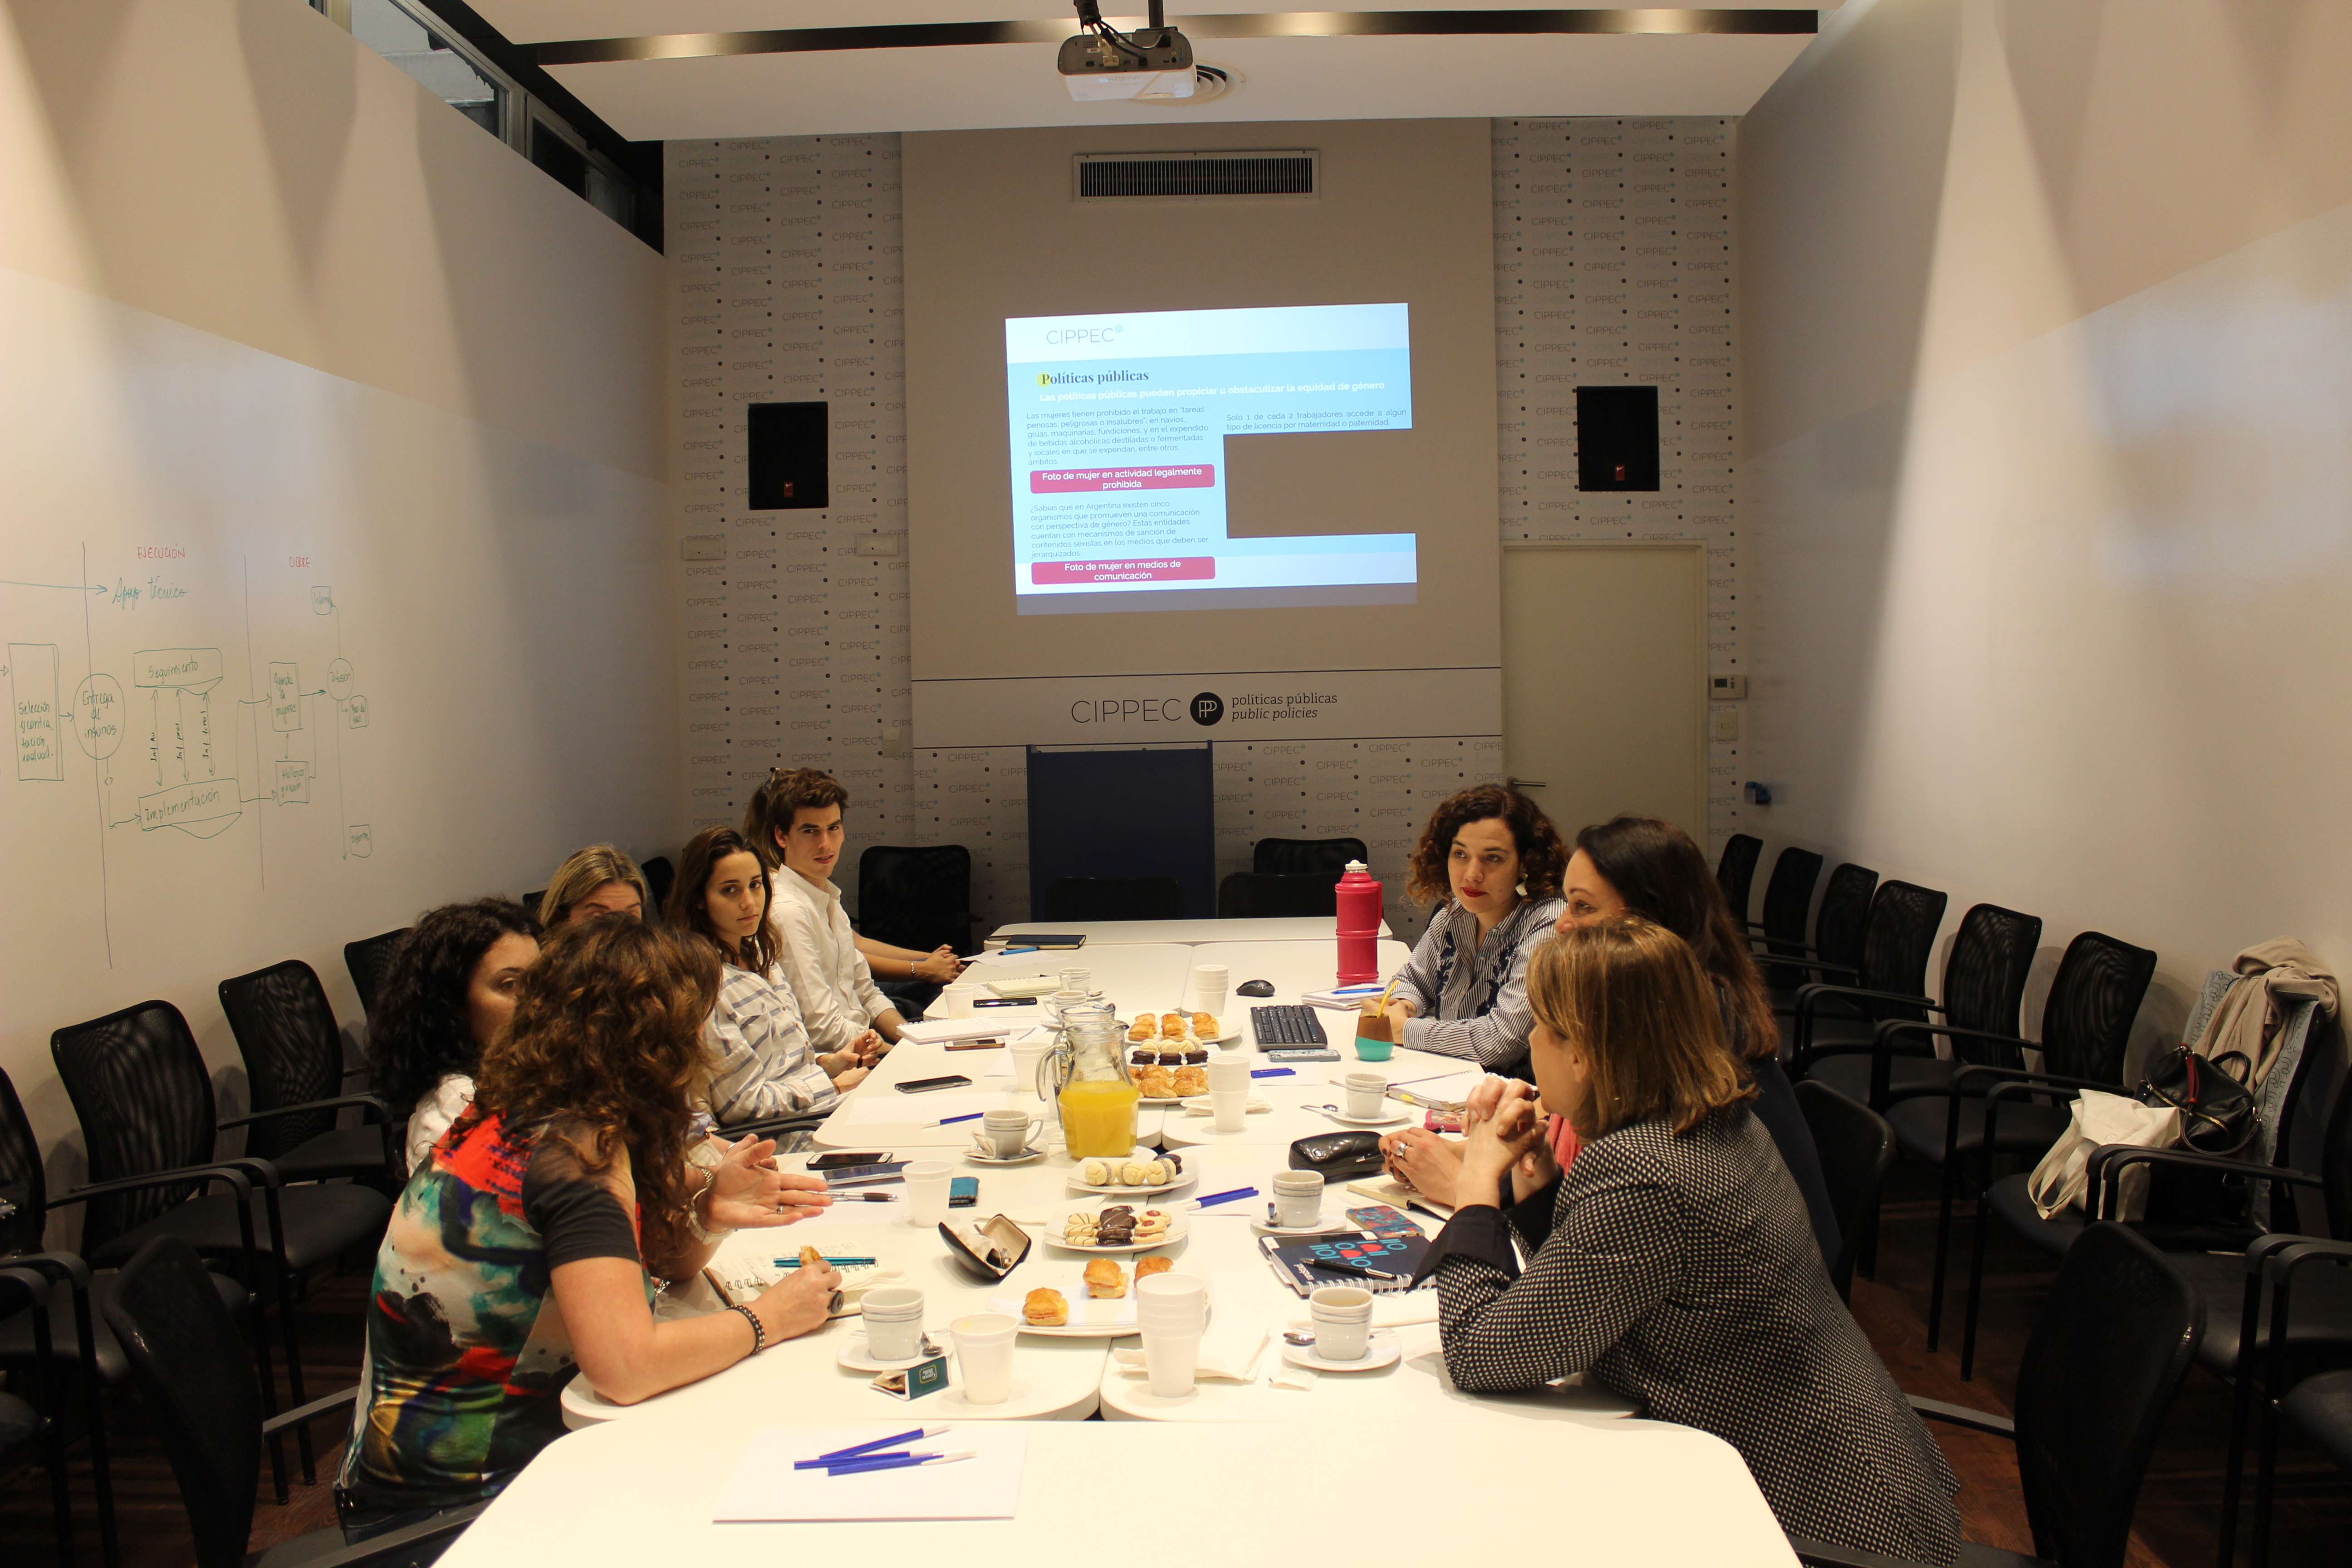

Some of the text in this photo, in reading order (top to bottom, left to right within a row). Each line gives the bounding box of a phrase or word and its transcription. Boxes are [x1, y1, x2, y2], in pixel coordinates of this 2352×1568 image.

[1632, 120, 1670, 130] CIPPEC
[831, 137, 867, 147] CIPPEC
[679, 159, 715, 168] CIPPEC
[1686, 230, 1726, 240] CIPPEC
[781, 249, 818, 258] CIPPEC
[1532, 247, 1571, 256] CIPPEC
[1046, 328, 1114, 344] CIPPEC
[1042, 370, 1148, 385] Políticas públicas
[1058, 391, 1097, 402] políticas
[1098, 390, 1137, 401] públicas
[1139, 388, 1175, 399] pueden
[1176, 387, 1218, 397] propiciar
[1228, 384, 1284, 394] obstaculizar
[1286, 383, 1295, 392] la
[1297, 382, 1335, 393] equidad
[1337, 382, 1350, 390] de
[1352, 381, 1385, 391] género
[1041, 411, 1070, 420] mujeres
[1096, 408, 1131, 418] prohibido
[1141, 407, 1166, 415] trabajo
[1297, 411, 1343, 420] trabajadores
[1385, 408, 1406, 417] algún
[1060, 420, 1098, 429] peligrosas
[1169, 424, 1208, 433] expendido
[1226, 423, 1240, 431] tipo
[1298, 420, 1340, 428] maternidad
[1063, 471, 1074, 480] de
[1076, 471, 1100, 480] mujer
[1114, 468, 1152, 477] actividad
[1154, 467, 1202, 478] legalmente
[1102, 480, 1142, 490] prohibida
[1086, 502, 1121, 511] Argentina
[1030, 513, 1072, 522] organismos
[1149, 508, 1200, 516] comunicación
[1046, 521, 1088, 531] perspectiva
[137, 543, 186, 559] EJECUCIÓN
[1098, 562, 1122, 571] mujer
[1137, 560, 1168, 568] medios
[1094, 571, 1152, 580] comunicación
[147, 575, 188, 599] técnico
[688, 660, 725, 669] CIPPEC
[1231, 693, 1337, 707] políticas públicas
[1071, 698, 1181, 723] CIPPEC
[1232, 708, 1318, 722] public policies
[790, 721, 827, 730] CIPPEC
[1264, 746, 1299, 755] CIPPEC
